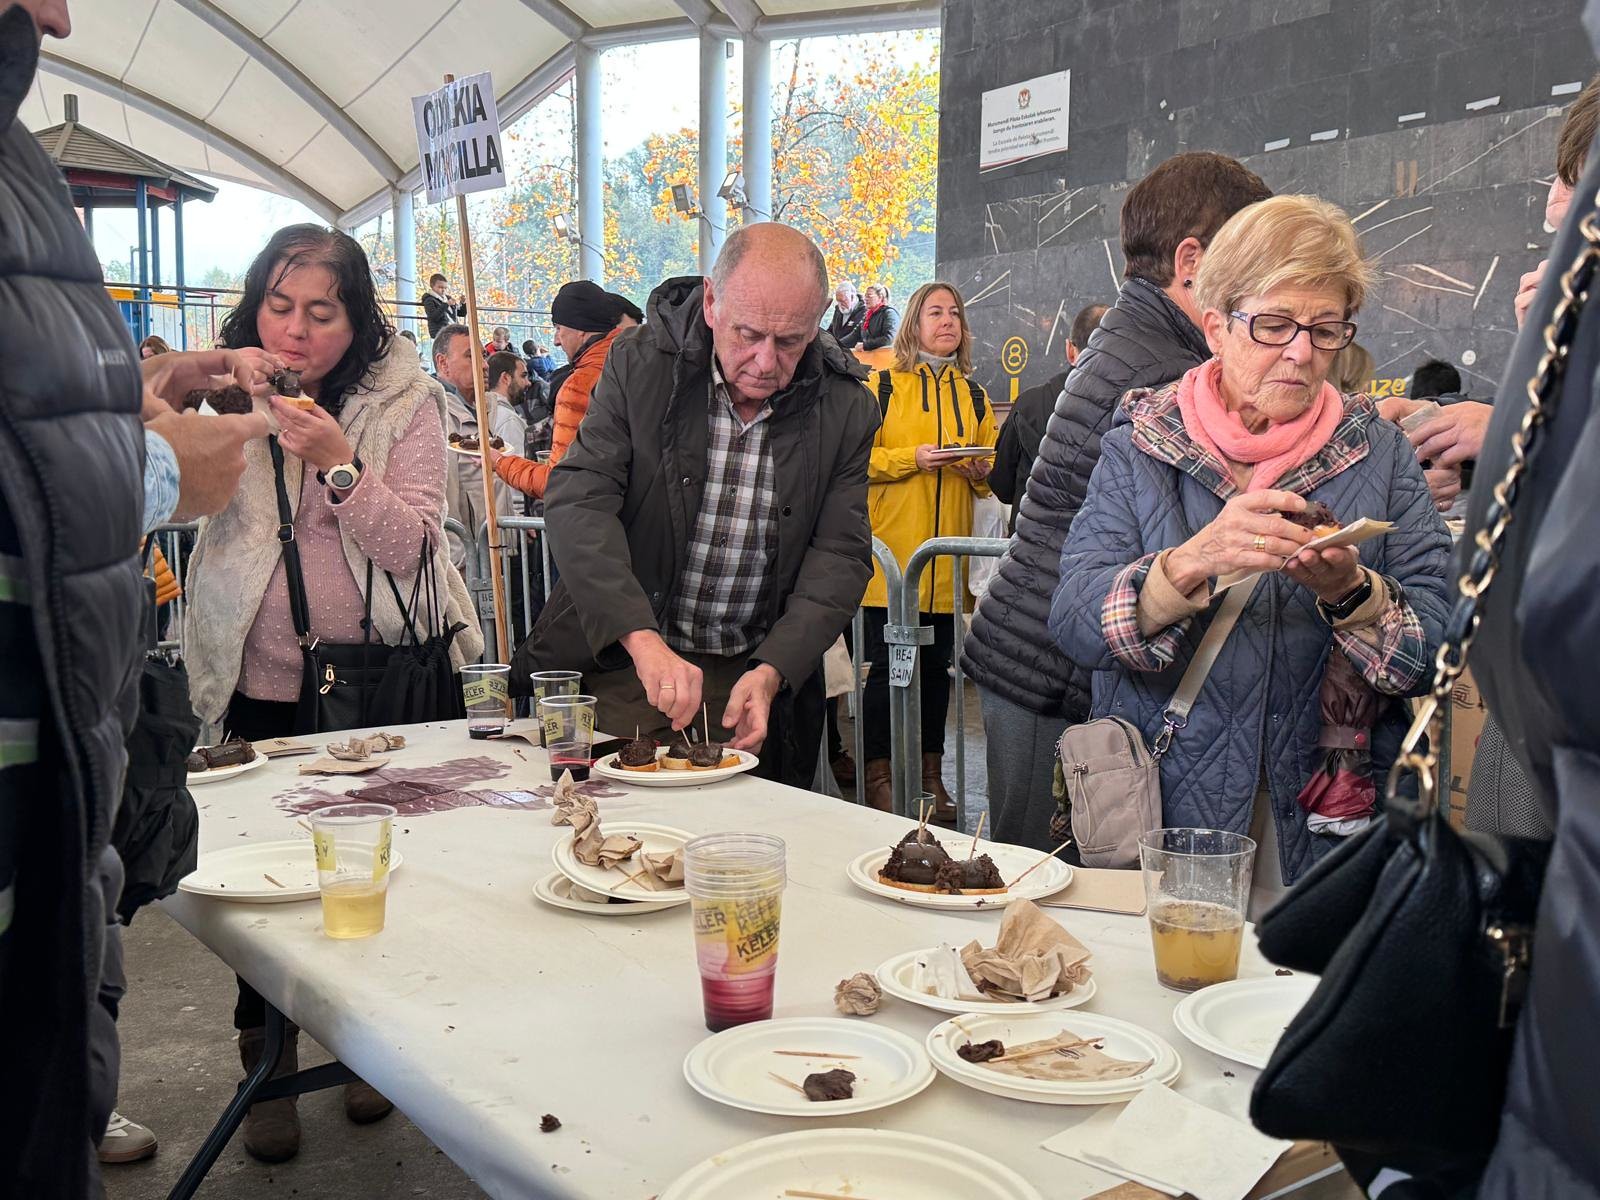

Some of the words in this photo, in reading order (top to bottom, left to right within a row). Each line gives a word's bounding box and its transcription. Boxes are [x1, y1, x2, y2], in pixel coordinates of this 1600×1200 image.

[1008, 343, 1021, 367] 8
[896, 648, 912, 662] BEA
[695, 911, 727, 930] LER
